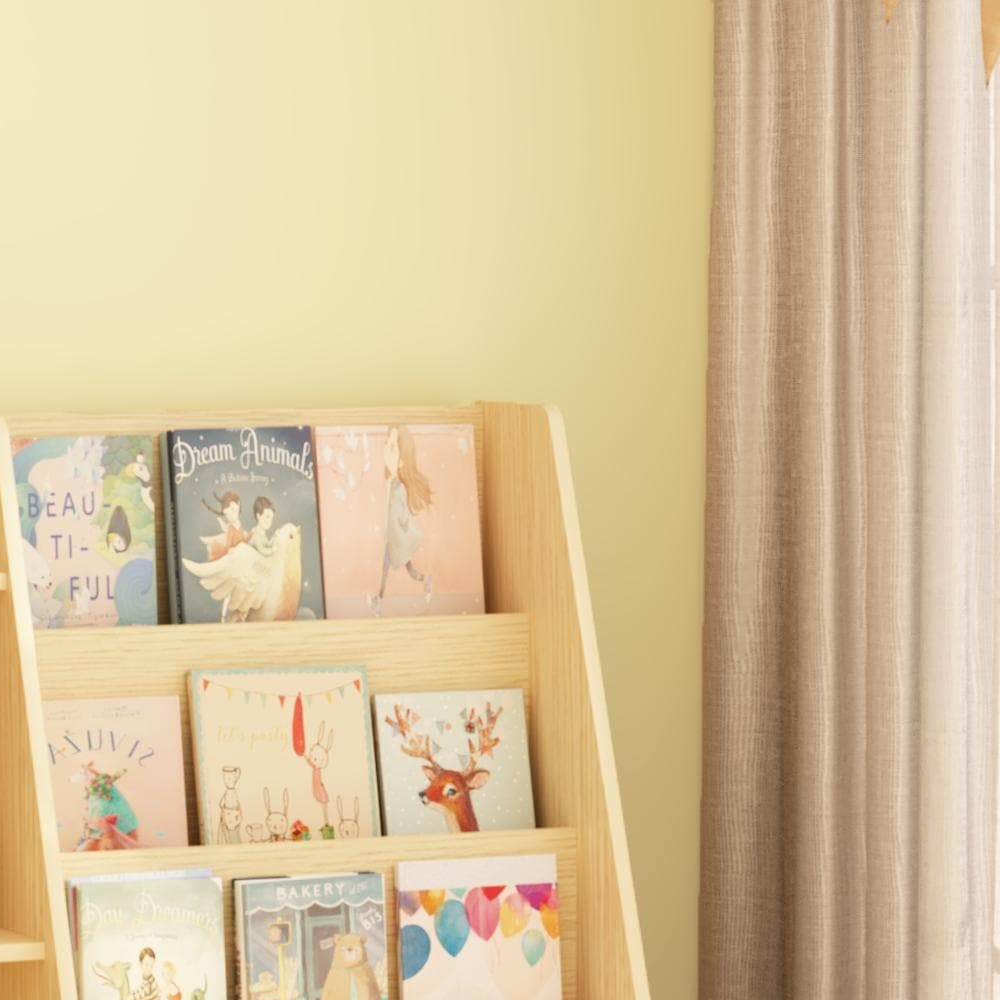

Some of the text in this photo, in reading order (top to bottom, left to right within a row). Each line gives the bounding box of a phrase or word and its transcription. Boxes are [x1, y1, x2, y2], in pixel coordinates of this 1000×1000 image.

[173, 427, 314, 484] Dream Animals
[28, 491, 111, 518] BEAU-
[50, 534, 89, 560] TI-
[69, 576, 115, 601] FUL
[276, 881, 345, 901] BAKERY
